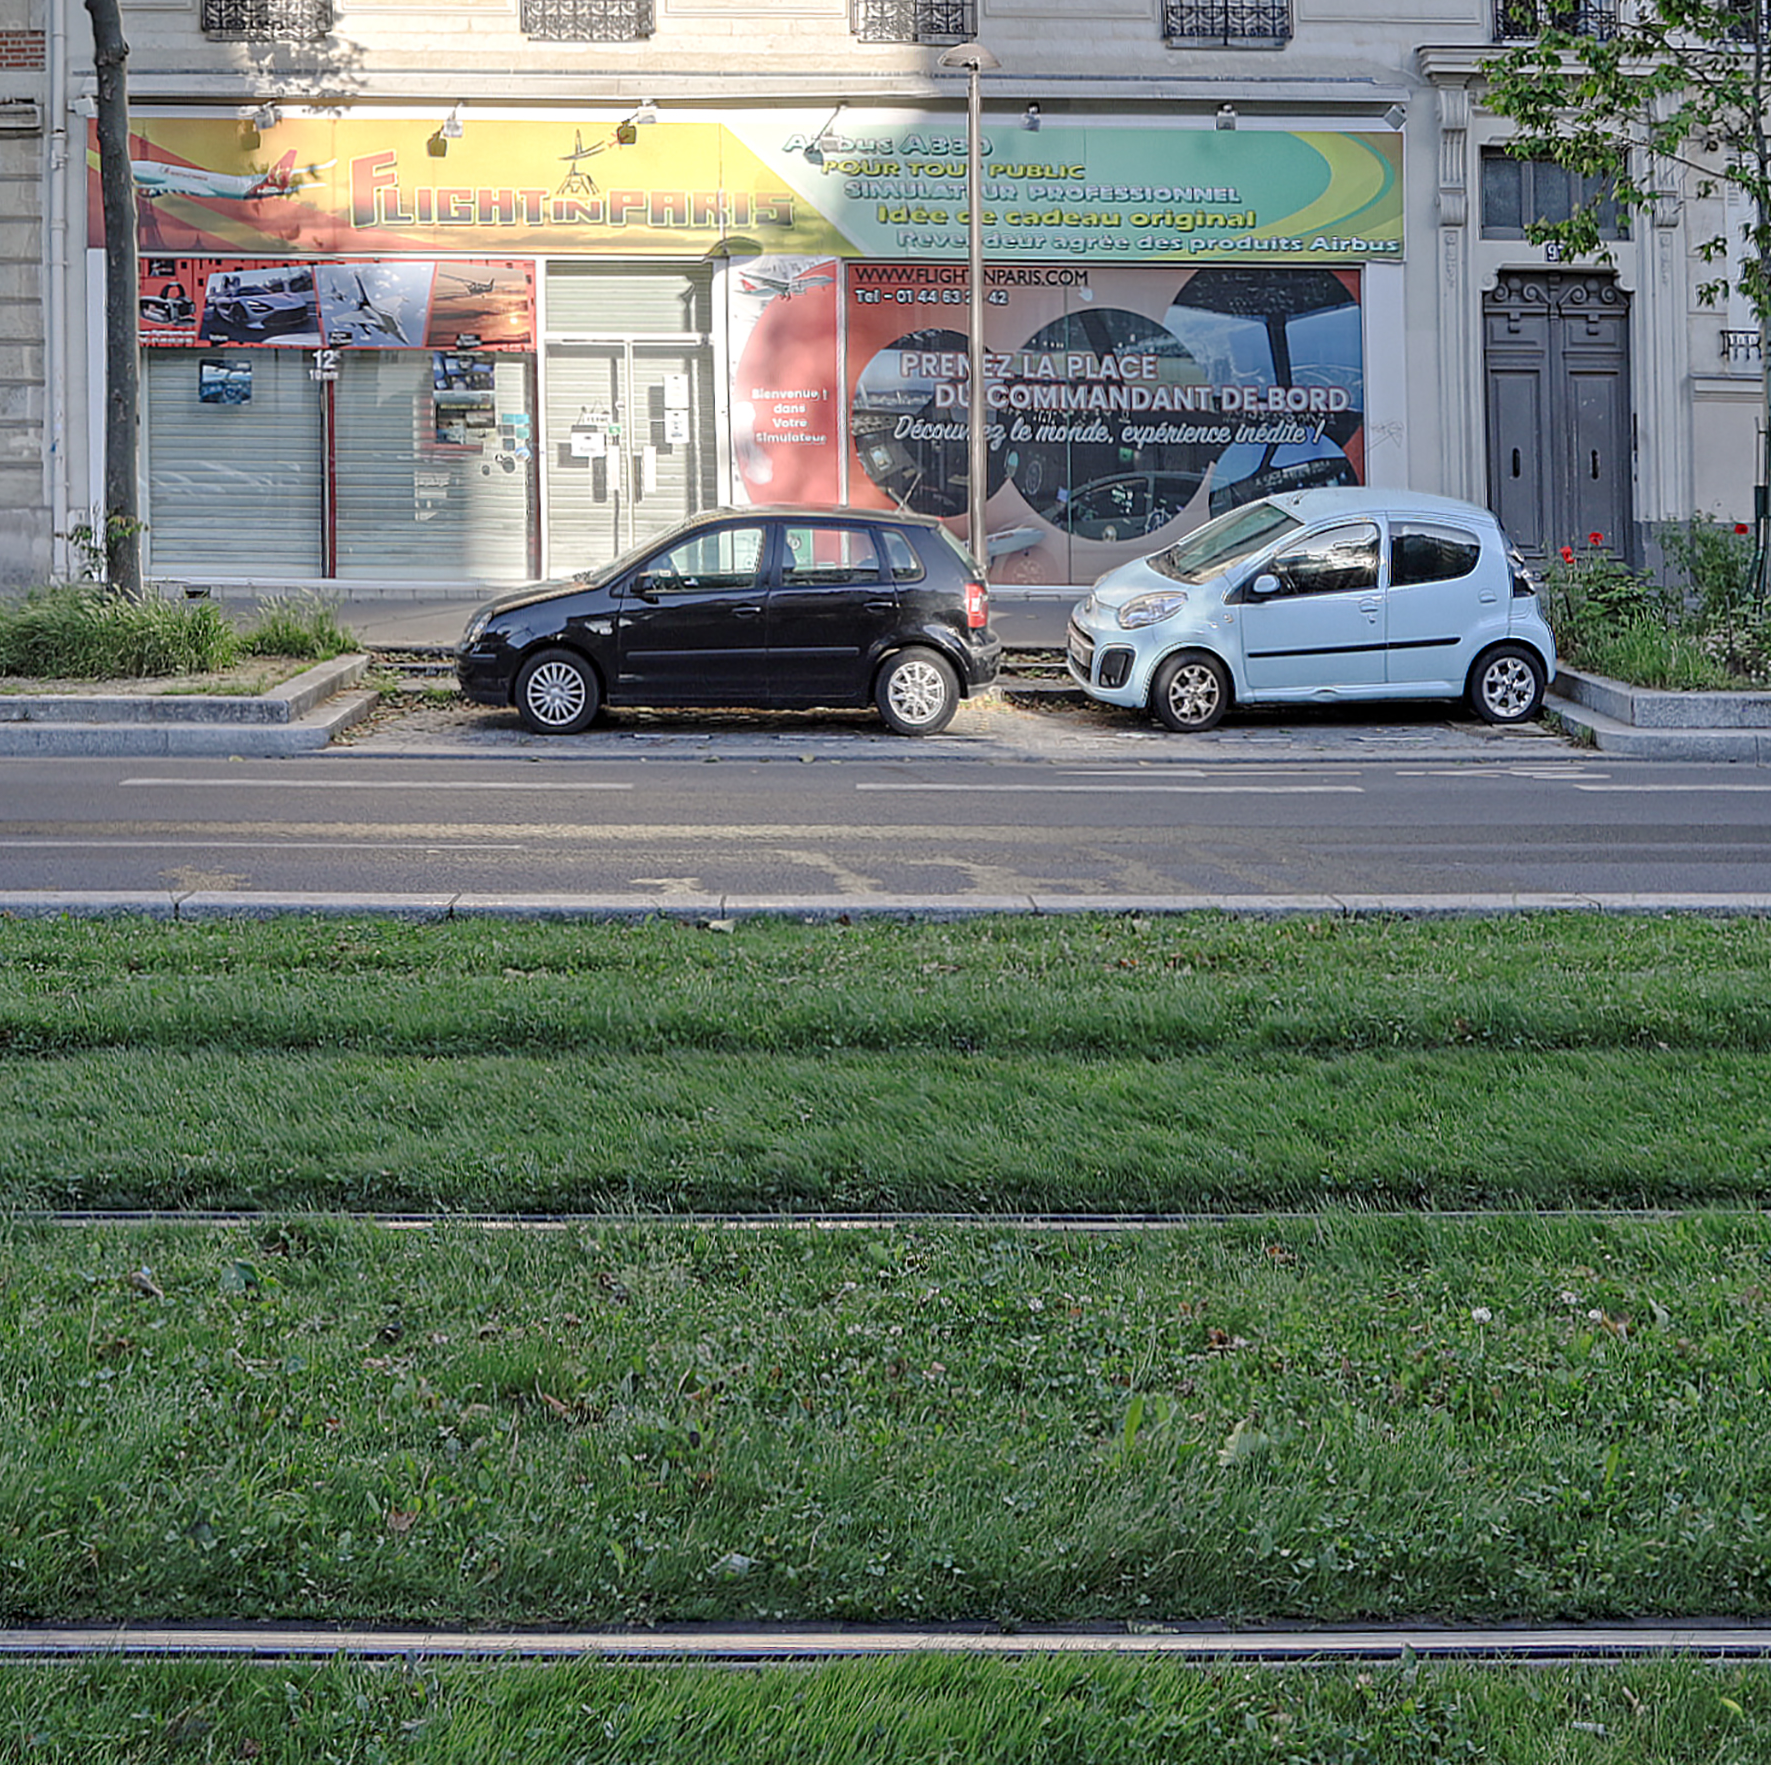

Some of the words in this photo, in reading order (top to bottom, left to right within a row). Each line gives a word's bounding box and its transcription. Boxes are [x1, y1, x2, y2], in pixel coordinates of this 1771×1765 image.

[821, 159, 901, 178] POUR
[907, 162, 983, 178] TOU
[989, 163, 1086, 180] PUBLIC
[844, 180, 1018, 202] SIMULATUR
[1028, 186, 1242, 204] PROFESSIONNEL
[605, 189, 795, 229] PARIS
[1004, 208, 1121, 228] cadeau
[1128, 209, 1256, 232] original
[897, 230, 1046, 250] Revedeur
[1135, 236, 1183, 251] des
[1188, 236, 1304, 254] produits
[1309, 236, 1402, 253] Airbus
[855, 289, 880, 303] Tel
[896, 290, 913, 304] 01
[917, 290, 939, 304] 44
[942, 290, 961, 304] 63
[988, 290, 1009, 305] 42
[1022, 353, 1057, 380] LA
[1067, 354, 1158, 380] PLACE
[751, 388, 819, 402] Bienvenue
[986, 385, 1213, 412] COMMANDANT
[1221, 387, 1258, 413] DE
[1267, 387, 1350, 413] BORD
[773, 403, 807, 415] dans
[772, 417, 808, 429] Votre
[1010, 416, 1032, 443] le
[1035, 418, 1114, 445] monde,
[1121, 421, 1232, 450] expérience
[1235, 422, 1307, 446] inédite
